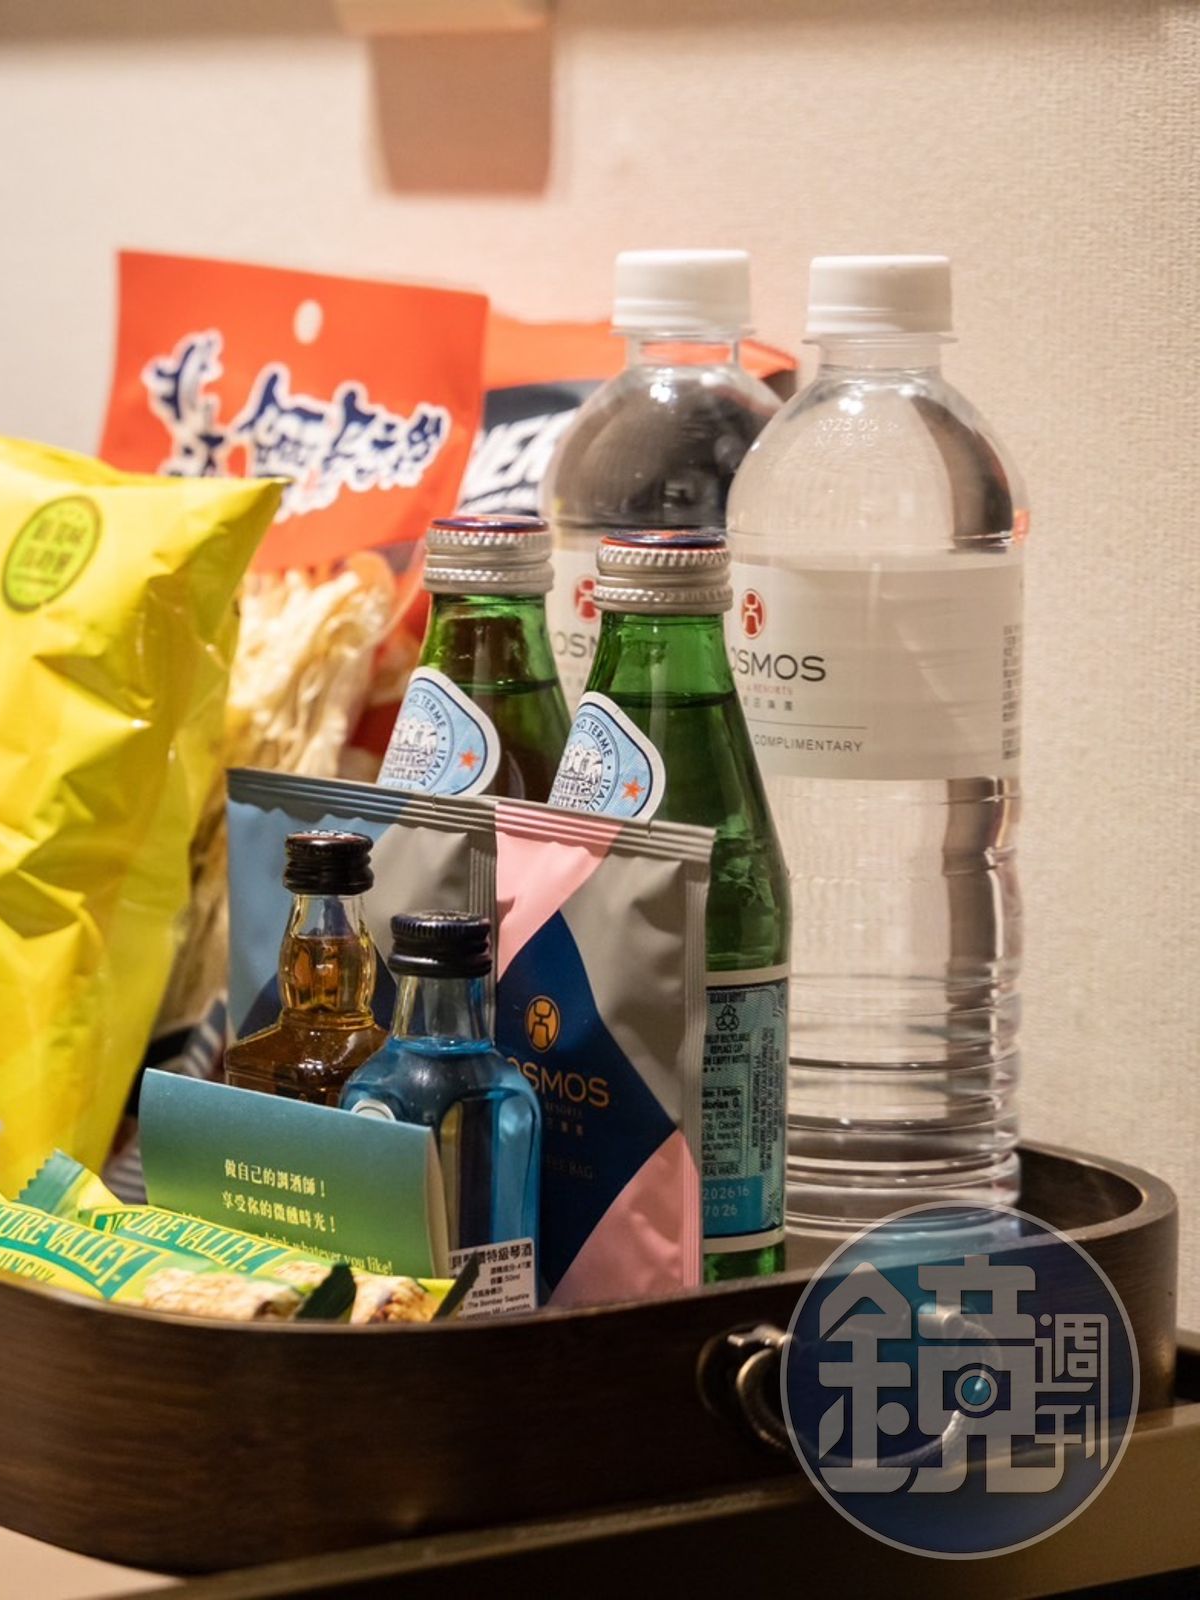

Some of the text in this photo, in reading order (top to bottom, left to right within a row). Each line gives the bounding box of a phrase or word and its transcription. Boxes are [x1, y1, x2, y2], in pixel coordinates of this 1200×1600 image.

[421, 695, 447, 728] TERME
[588, 721, 614, 758] TERME
[753, 733, 864, 753] COMPLIMENTARY
[224, 1158, 326, 1198] 做自己的調酒師！
[44, 1219, 148, 1287] VALLEY
[174, 1218, 280, 1270] VALLEY
[365, 1255, 394, 1277] like!
